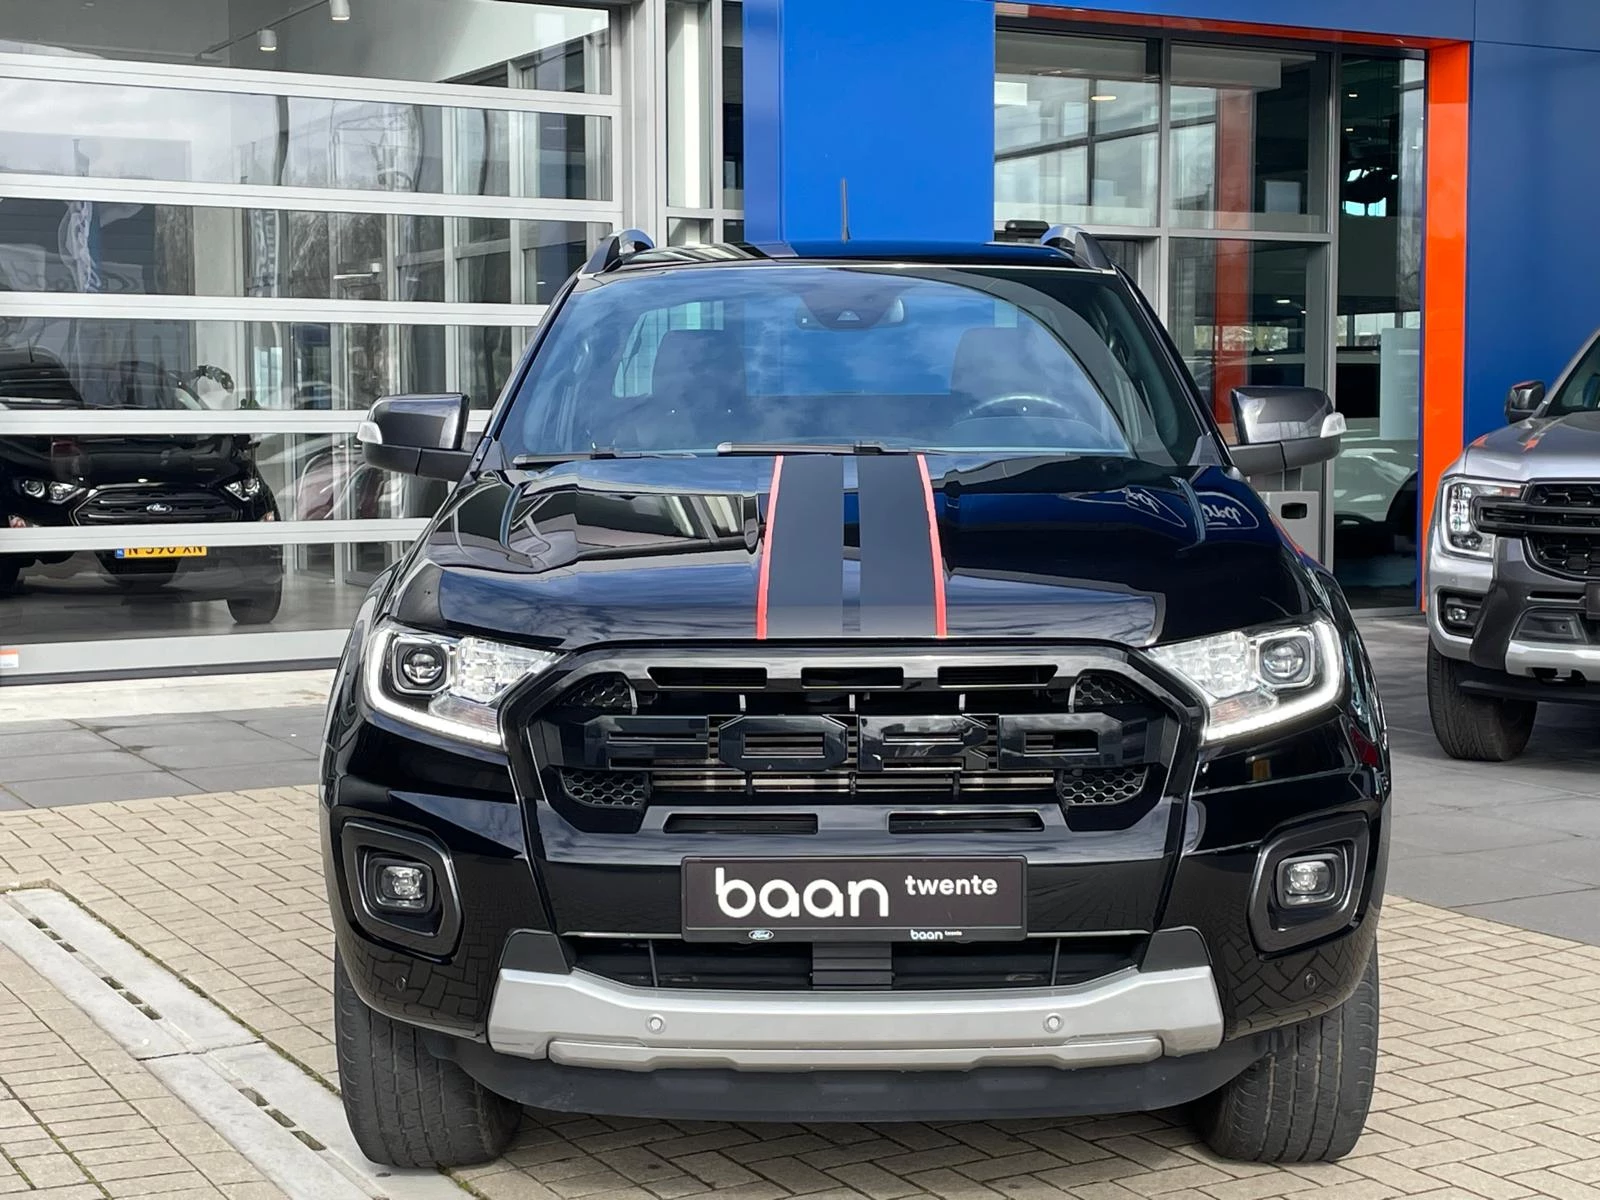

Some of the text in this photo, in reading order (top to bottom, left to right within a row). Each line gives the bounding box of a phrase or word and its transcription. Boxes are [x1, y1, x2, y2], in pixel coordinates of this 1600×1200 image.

[582, 714, 1128, 771] FORD
[715, 867, 998, 918] baan twente
[910, 929, 943, 940] baan
